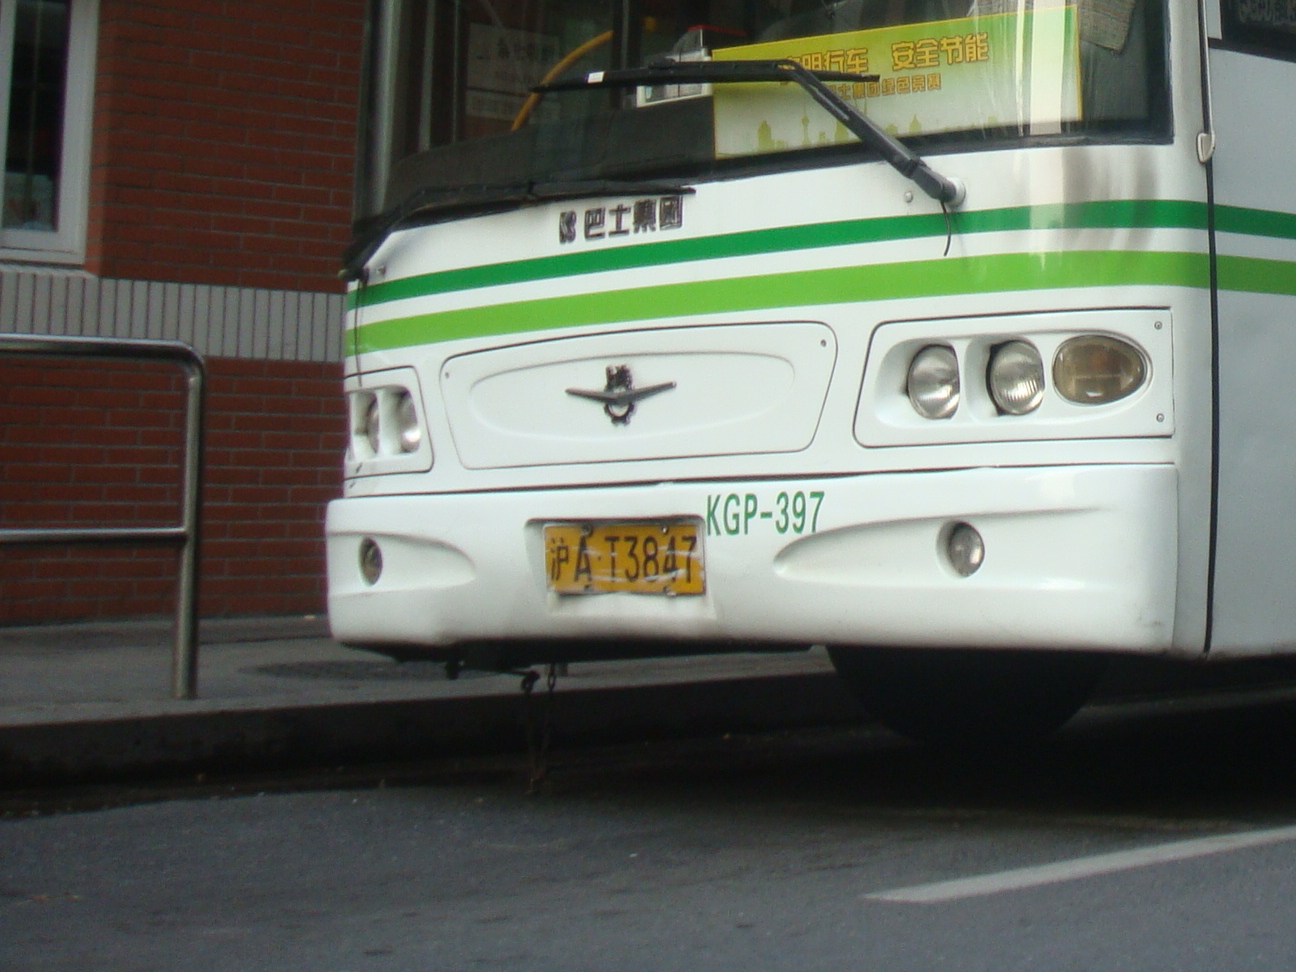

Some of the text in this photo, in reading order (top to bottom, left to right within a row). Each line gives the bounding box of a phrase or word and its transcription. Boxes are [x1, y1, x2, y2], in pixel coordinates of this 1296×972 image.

[891, 31, 989, 72] 安全节能
[584, 193, 683, 241] 巴士集团
[706, 490, 825, 537] KGP-397
